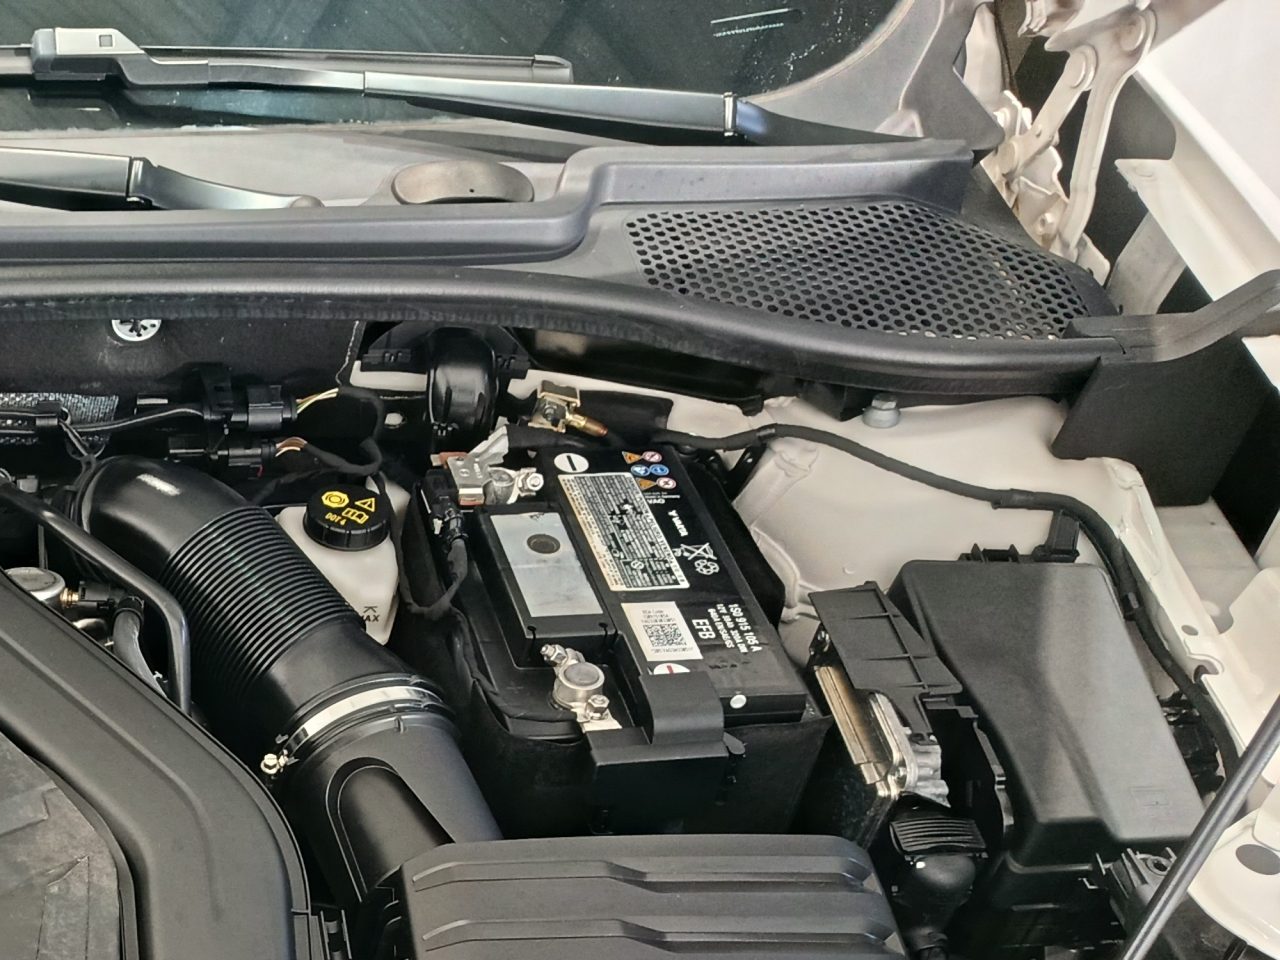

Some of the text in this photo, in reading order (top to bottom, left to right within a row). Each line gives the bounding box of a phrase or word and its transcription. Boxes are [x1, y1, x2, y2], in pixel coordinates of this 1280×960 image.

[324, 512, 341, 523] DOT
[691, 618, 716, 639] EFB
[735, 617, 752, 631] 915
[750, 645, 763, 653] A
